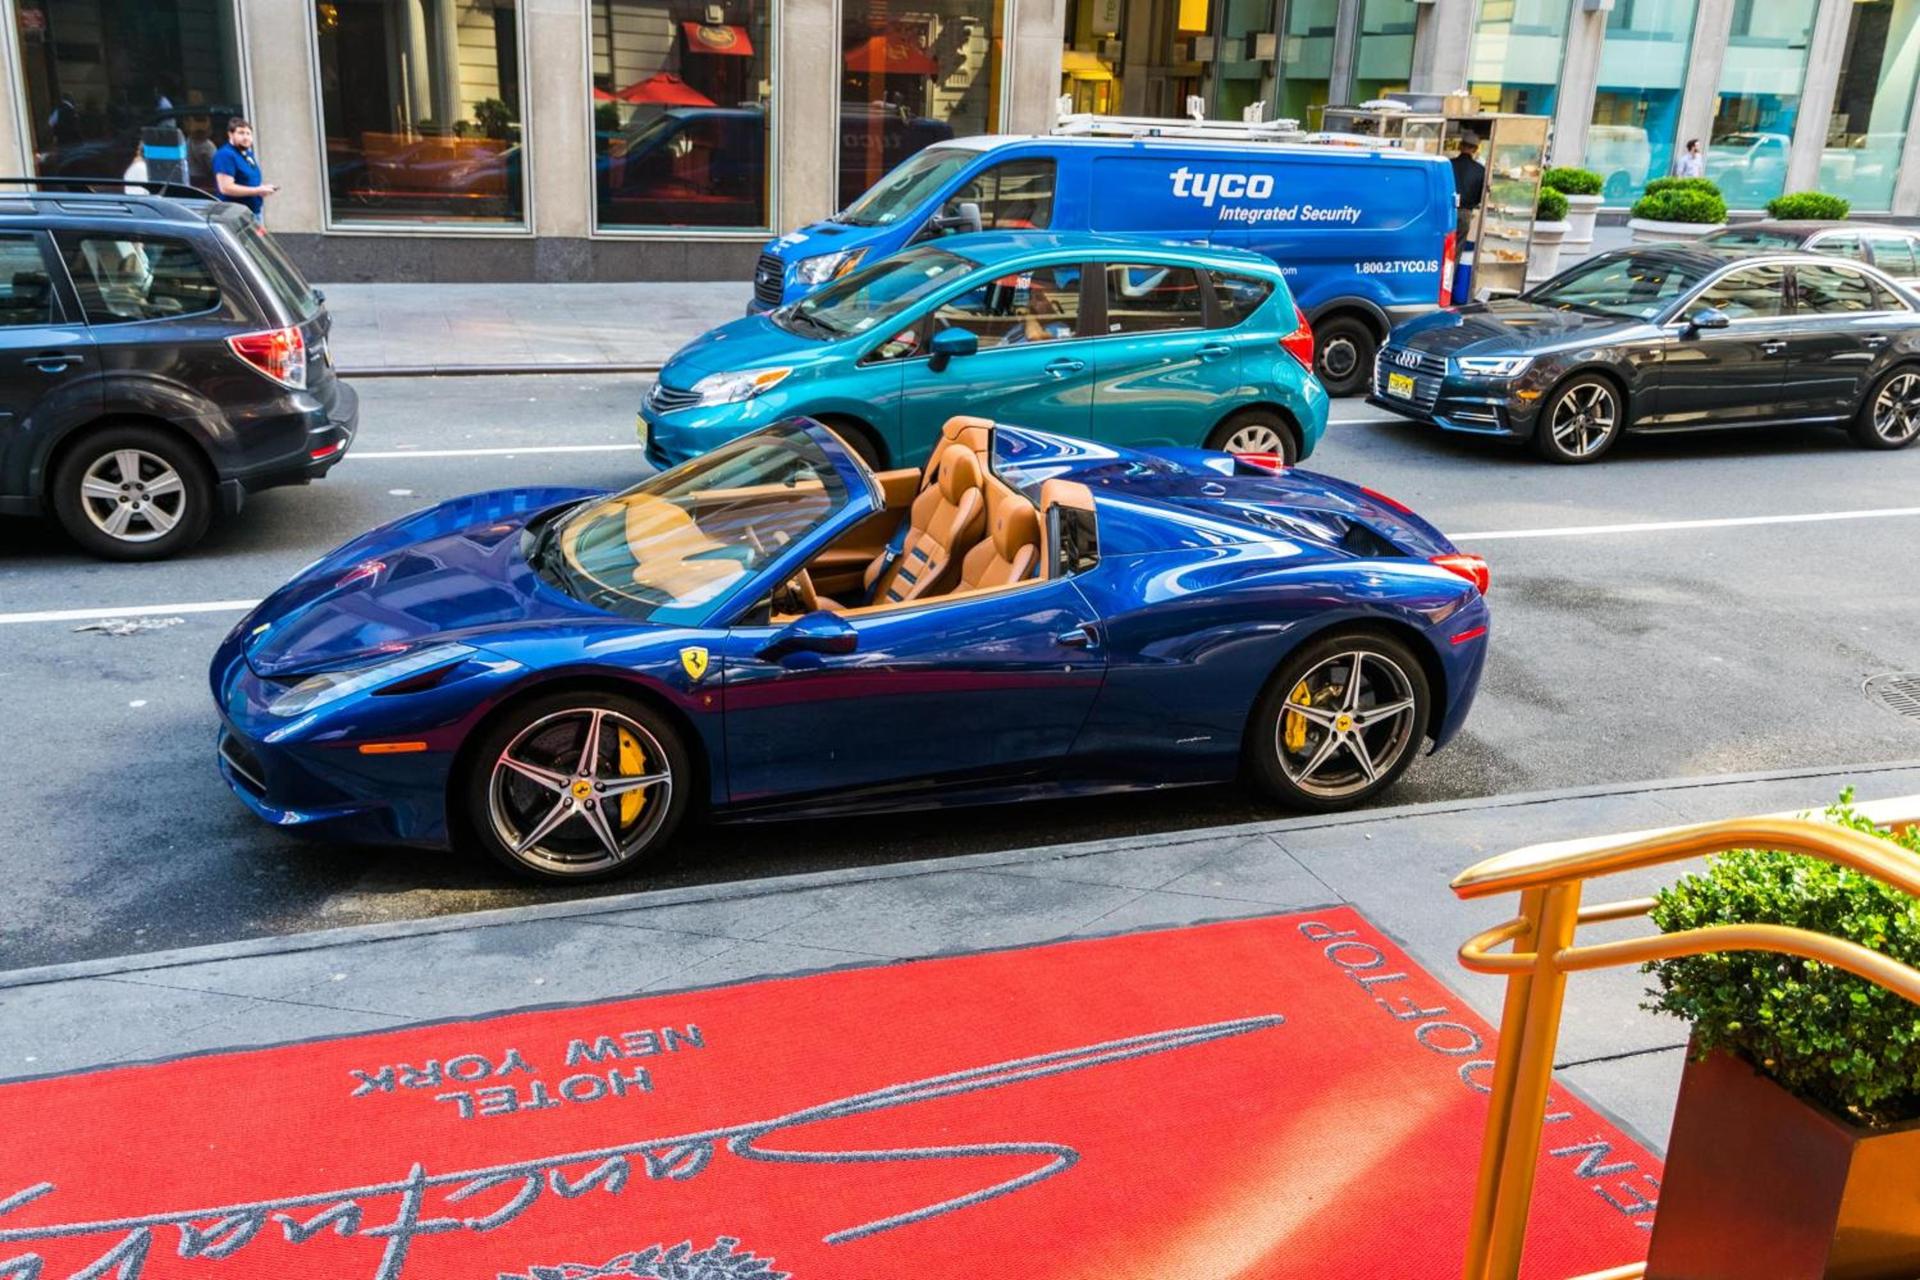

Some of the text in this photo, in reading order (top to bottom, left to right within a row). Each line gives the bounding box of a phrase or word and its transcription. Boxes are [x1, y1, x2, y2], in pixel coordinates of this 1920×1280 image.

[1169, 166, 1275, 207] tyco
[1219, 205, 1362, 225] Integrated Security
[1354, 260, 1439, 274] 1.800.2.TYCO.IS
[1297, 920, 1573, 1124] OOFTOP
[349, 1024, 706, 1098] NEW YORK
[434, 1066, 655, 1120] HOTEL
